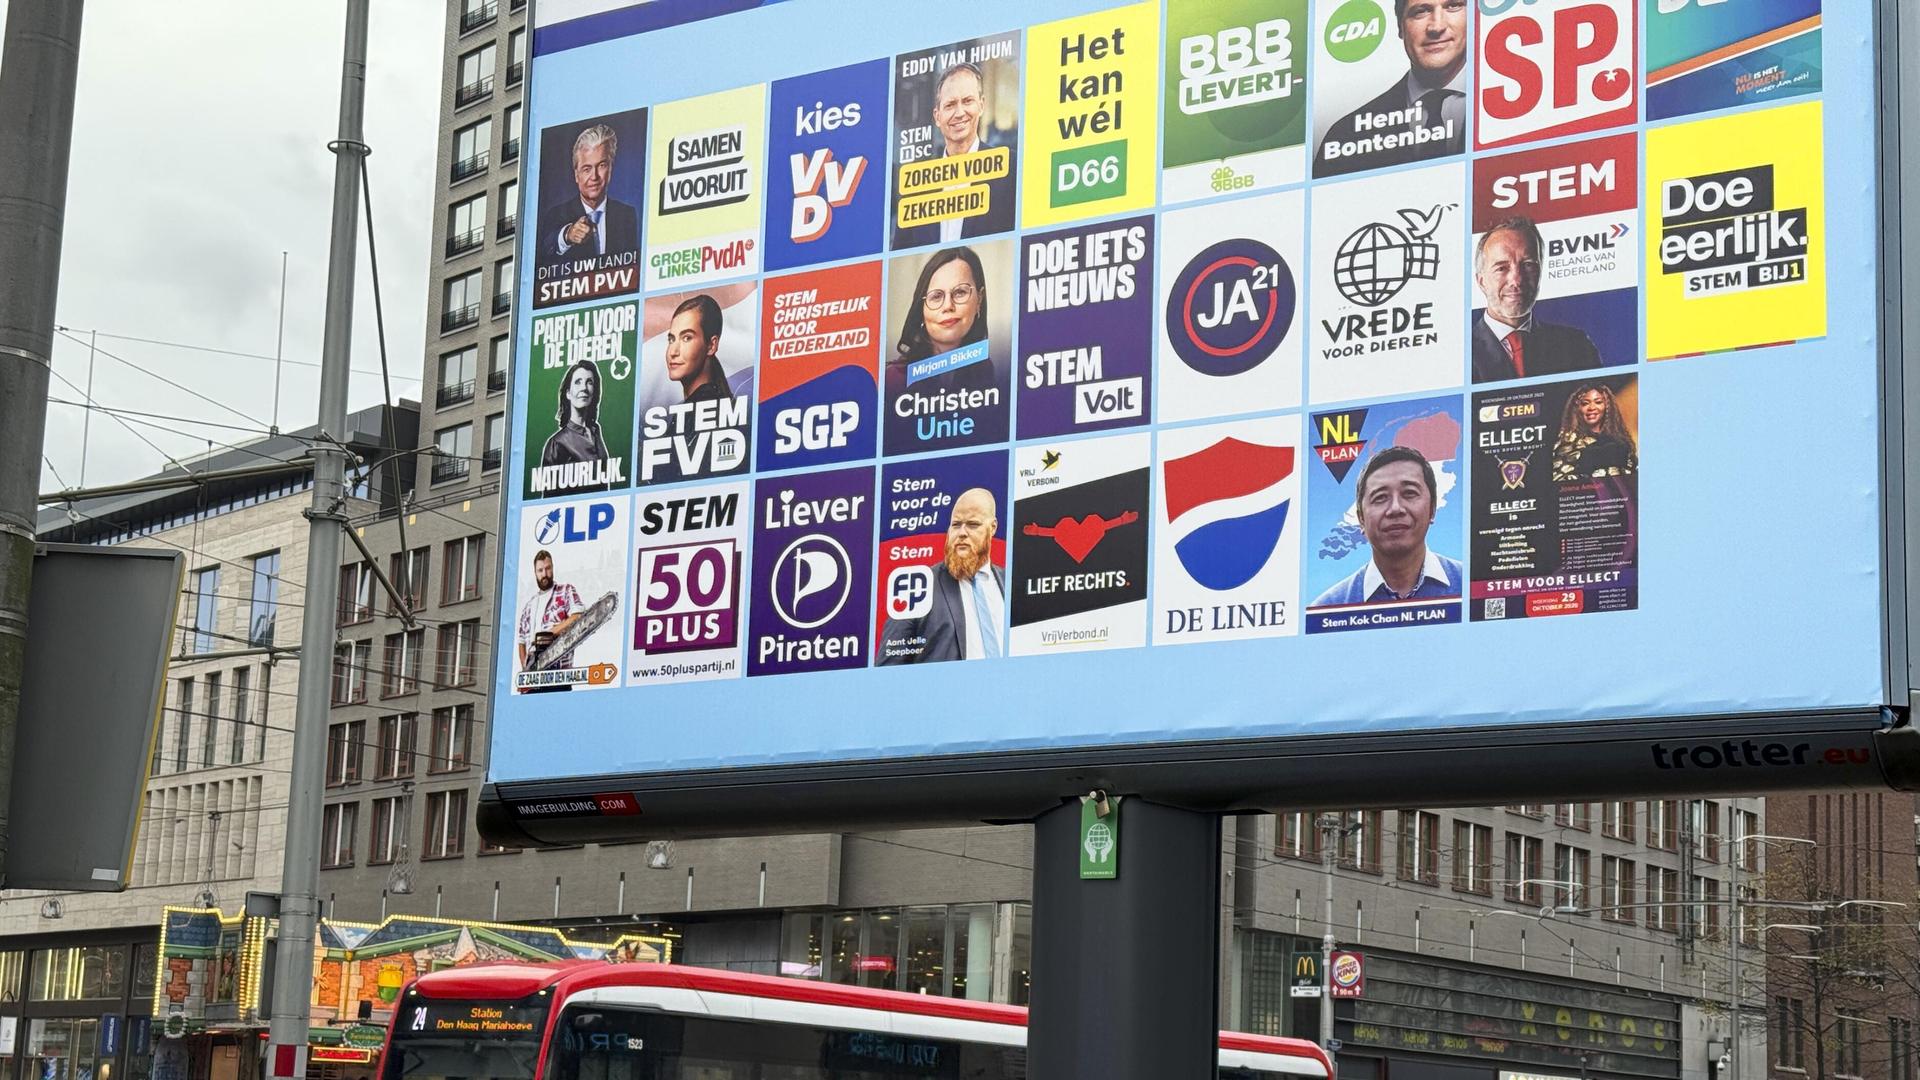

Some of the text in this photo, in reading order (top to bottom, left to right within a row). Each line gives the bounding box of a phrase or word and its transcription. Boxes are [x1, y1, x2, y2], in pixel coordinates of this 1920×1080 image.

[1329, 17, 1380, 44] CDA
[902, 40, 1013, 78] EDDY VAN HIJUM
[1060, 28, 1125, 67] Het
[1180, 19, 1293, 79] BBB
[1059, 71, 1123, 103] kan
[796, 101, 861, 136] kies
[1058, 100, 1122, 140] wél
[1355, 101, 1423, 132] Henri
[677, 131, 741, 163] SAMEN
[901, 126, 932, 145] STEM
[1324, 120, 1453, 160] Bontenbal
[669, 169, 748, 203] VOORUIT
[905, 155, 1004, 188] ZORGEN VOOR
[1058, 155, 1119, 192] D66
[1223, 175, 1255, 191] BBB
[1492, 159, 1616, 209] STEM
[903, 192, 985, 221] ZEKERHEID!
[1662, 177, 1753, 218] Doe
[1029, 226, 1146, 277] DOE IETS
[1548, 232, 1616, 257] BVNL
[1662, 211, 1809, 266] eerlijk.
[538, 251, 637, 281] DIT IS UW LAND!
[651, 248, 701, 270] GROEN
[659, 261, 701, 280] LINKS
[702, 240, 745, 273] PvdA
[1548, 252, 1616, 269] BELANG VAN
[1548, 262, 1616, 280] NEDERLAND
[541, 268, 634, 301] STEM PVV
[1028, 264, 1136, 313] NIEUWS
[1690, 263, 1801, 292] STEM BIJ1
[774, 296, 871, 324] CHRISTELIJK
[775, 289, 818, 308] STEM
[534, 305, 636, 345] PARTIJ VOOR
[774, 321, 817, 339] VOOR
[1322, 303, 1434, 344] VREDE
[545, 332, 622, 369] DE DIEREN
[773, 332, 867, 358] NEDERLAND
[1323, 333, 1438, 360] VOOR DIEREN
[912, 347, 983, 377] Mirjam Bikker
[1026, 346, 1102, 389] STEM
[895, 387, 1000, 418] Christen
[1084, 387, 1135, 415] Volt
[1503, 404, 1535, 417] STEM
[644, 395, 748, 438] STEM
[775, 401, 860, 454] SGP
[917, 413, 975, 441] Unie
[1323, 414, 1358, 445] NL
[1480, 425, 1547, 448] ELLECT
[642, 429, 746, 481] FVD
[1322, 447, 1359, 461] PLAN
[531, 457, 626, 493] NATUURLIJK.
[892, 477, 936, 493] Stem
[1020, 469, 1036, 479] VRIJ
[1027, 476, 1060, 487] VERBOND
[640, 493, 739, 535] STEM
[766, 490, 865, 530] Liever
[891, 492, 951, 512] voor de
[1490, 499, 1536, 512] ELLECT
[563, 503, 615, 544] LP
[891, 512, 938, 532] regio!
[890, 545, 933, 561] Stem
[647, 547, 726, 612] 50
[1027, 571, 1131, 595] LIEF RECHTS.
[1487, 581, 1522, 592] STEM
[1527, 576, 1564, 588] VOOR
[1570, 571, 1620, 584] ELLECT
[1562, 593, 1576, 603] 29
[647, 613, 721, 645] PLUS
[1167, 601, 1286, 634] DE LINIE
[1323, 609, 1446, 628] Stem Kok Chan NL PLAN
[760, 634, 859, 664] Piraten
[886, 638, 906, 647] Aant
[1042, 626, 1109, 645] VrijVerbond.nl
[633, 660, 736, 678] www.50pluspartij.nl
[518, 802, 597, 815] IMAGEBUILDING
[1338, 967, 1357, 978] KING
[412, 1007, 428, 1031] 24
[437, 1020, 454, 1029] Den
[482, 1021, 533, 1030] Mariahoeve
[471, 1008, 503, 1019] Station
[628, 1039, 643, 1050] 1523
